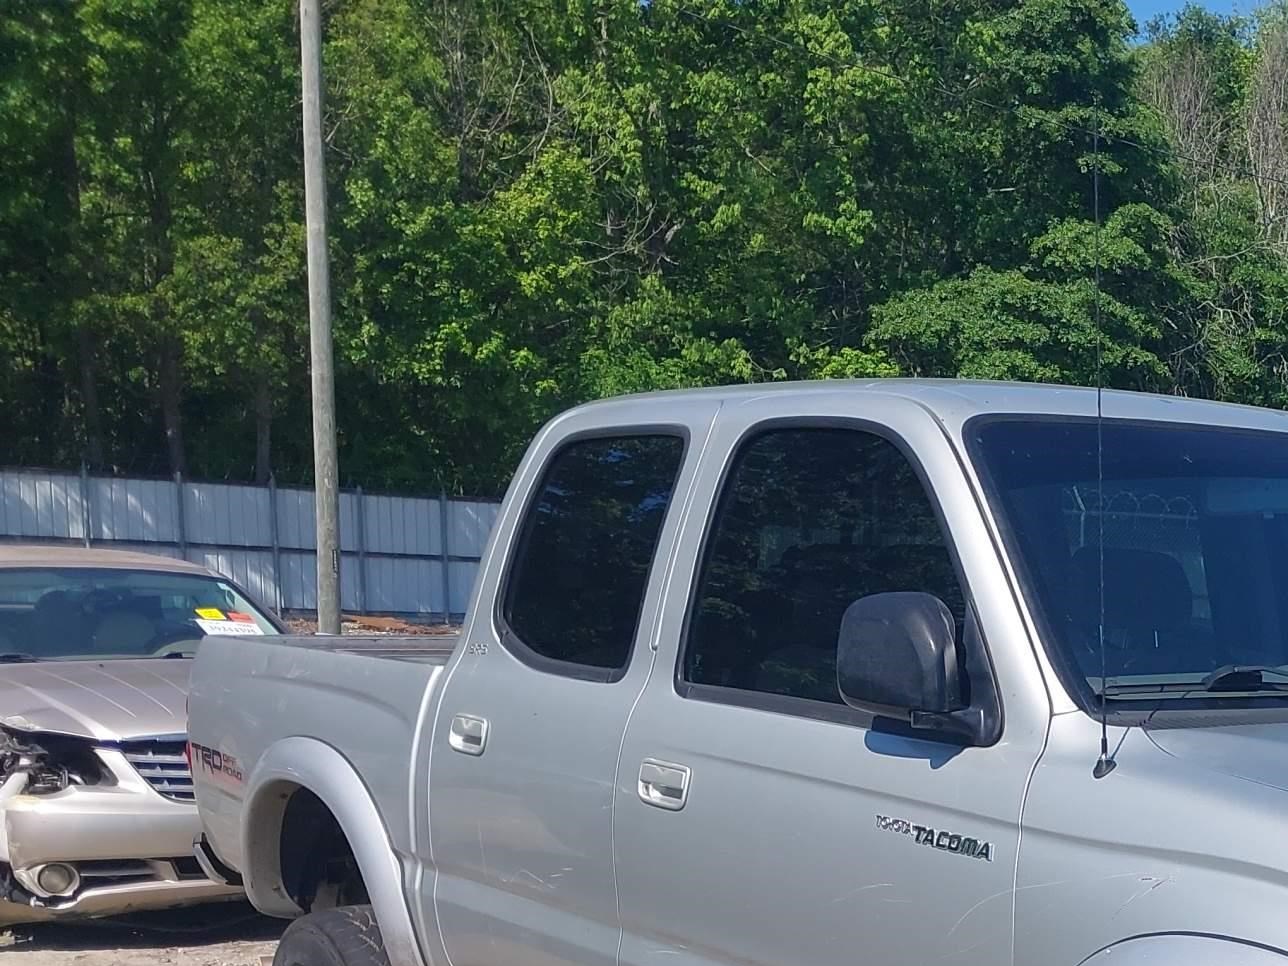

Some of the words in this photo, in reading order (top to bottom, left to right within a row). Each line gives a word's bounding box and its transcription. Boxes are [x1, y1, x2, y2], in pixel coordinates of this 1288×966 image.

[191, 742, 222, 774] TRD
[222, 765, 243, 781] ROAD
[875, 814, 914, 836] TOYOTA
[912, 825, 994, 862] TACOMA
